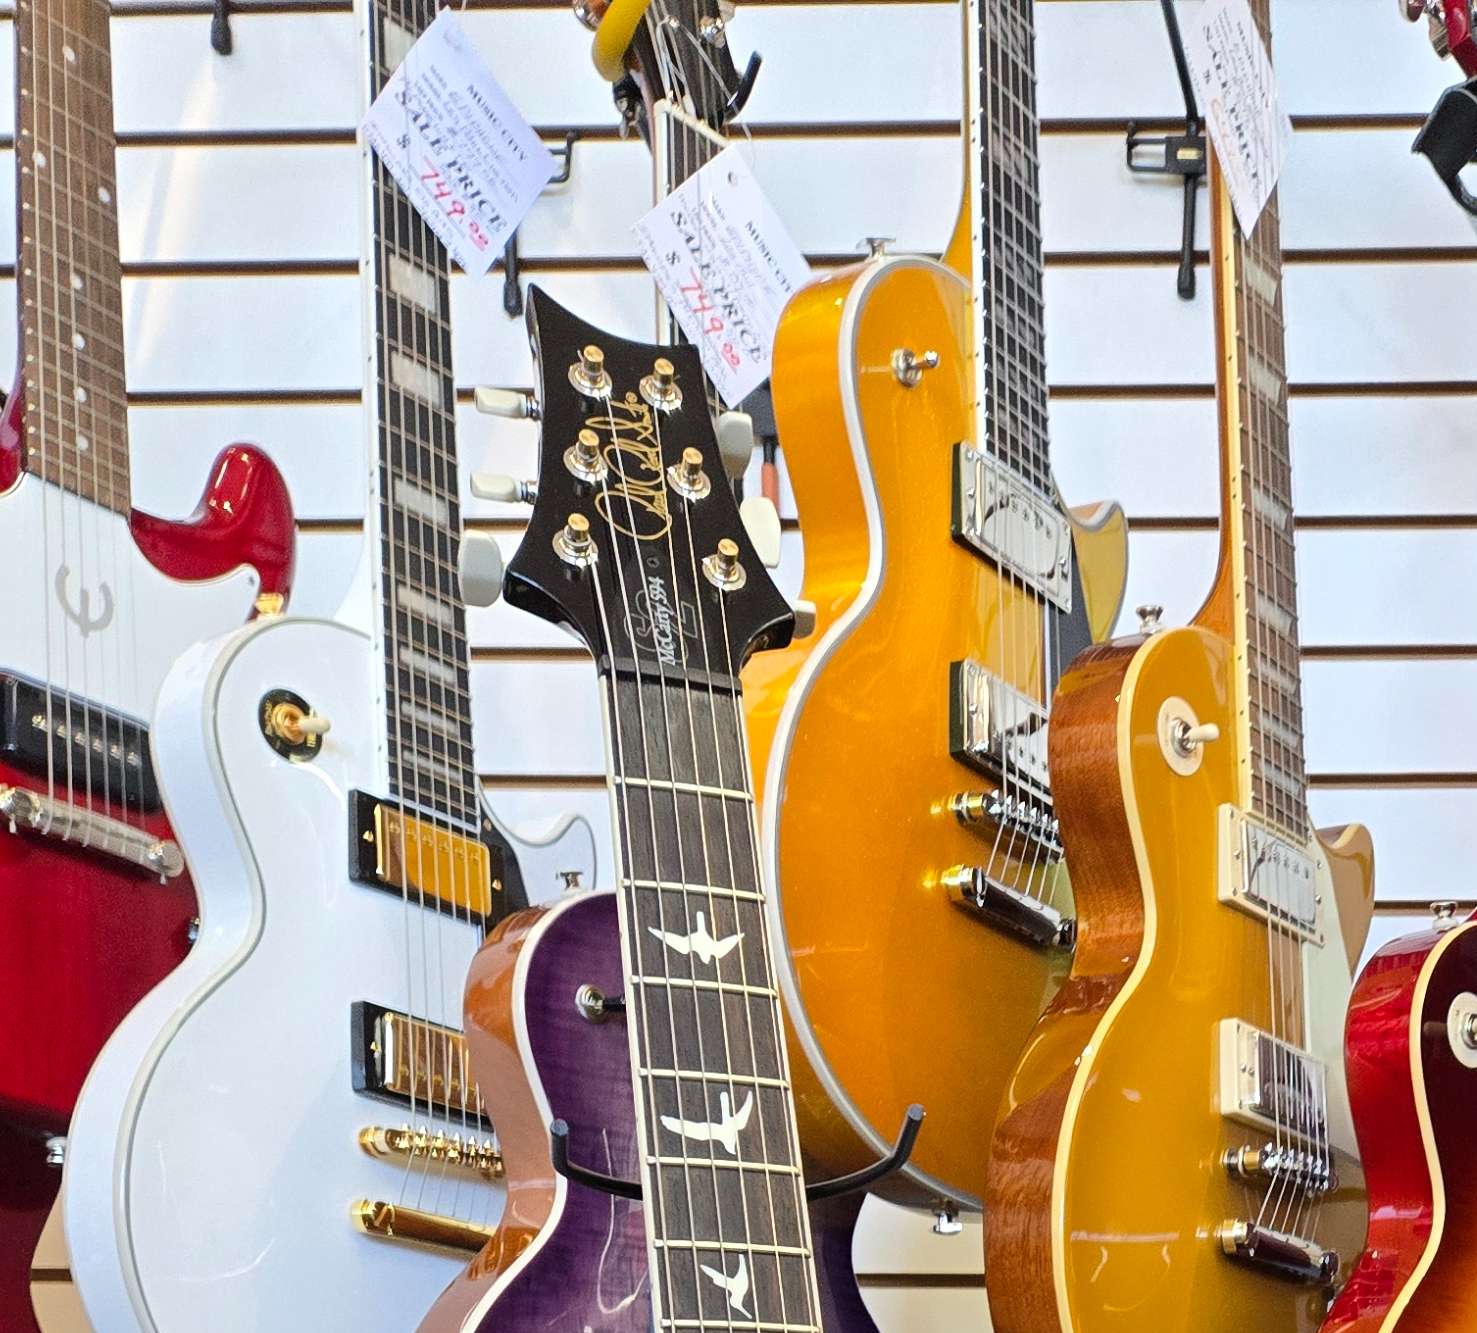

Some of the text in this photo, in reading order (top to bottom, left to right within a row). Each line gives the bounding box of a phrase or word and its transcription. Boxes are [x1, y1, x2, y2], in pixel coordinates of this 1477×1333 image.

[395, 90, 444, 157] SALE
[440, 158, 507, 233] PRICE
[396, 132, 412, 150] $
[500, 128, 528, 162] CITY
[664, 250, 681, 267] $
[745, 220, 774, 264] MUSIC
[669, 210, 716, 279] SALE
[712, 281, 768, 364] PRICE
[648, 576, 676, 666] McCarty 594
